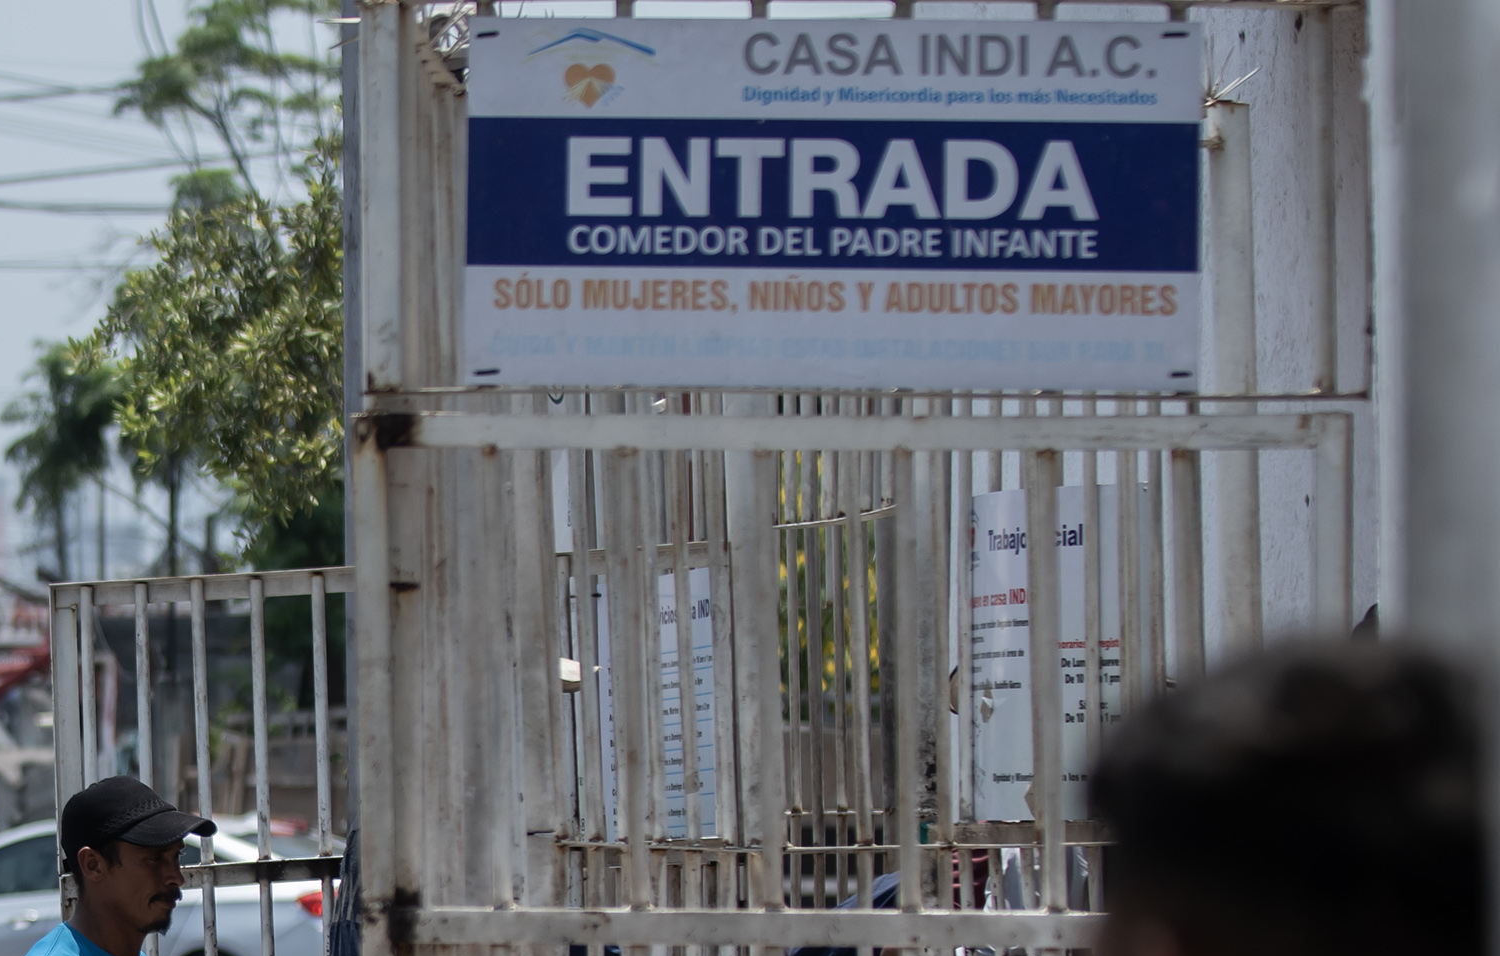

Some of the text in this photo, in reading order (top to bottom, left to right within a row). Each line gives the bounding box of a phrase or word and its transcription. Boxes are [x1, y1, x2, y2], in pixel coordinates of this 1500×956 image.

[743, 31, 1160, 79] CASA INDI A.C.
[743, 86, 1159, 107] Dignidad y Misericordia para los más Necesitados
[566, 135, 1100, 222] ENTRADA
[567, 225, 1098, 259] COMEDOR DEL PADRE INFANTE
[493, 272, 1179, 317] SÓLO MUJERES, NIÑOS Y ADULTOS MAYORES
[1055, 523, 1084, 548] cial
[697, 599, 710, 619] IND
[1009, 588, 1030, 605] IND
